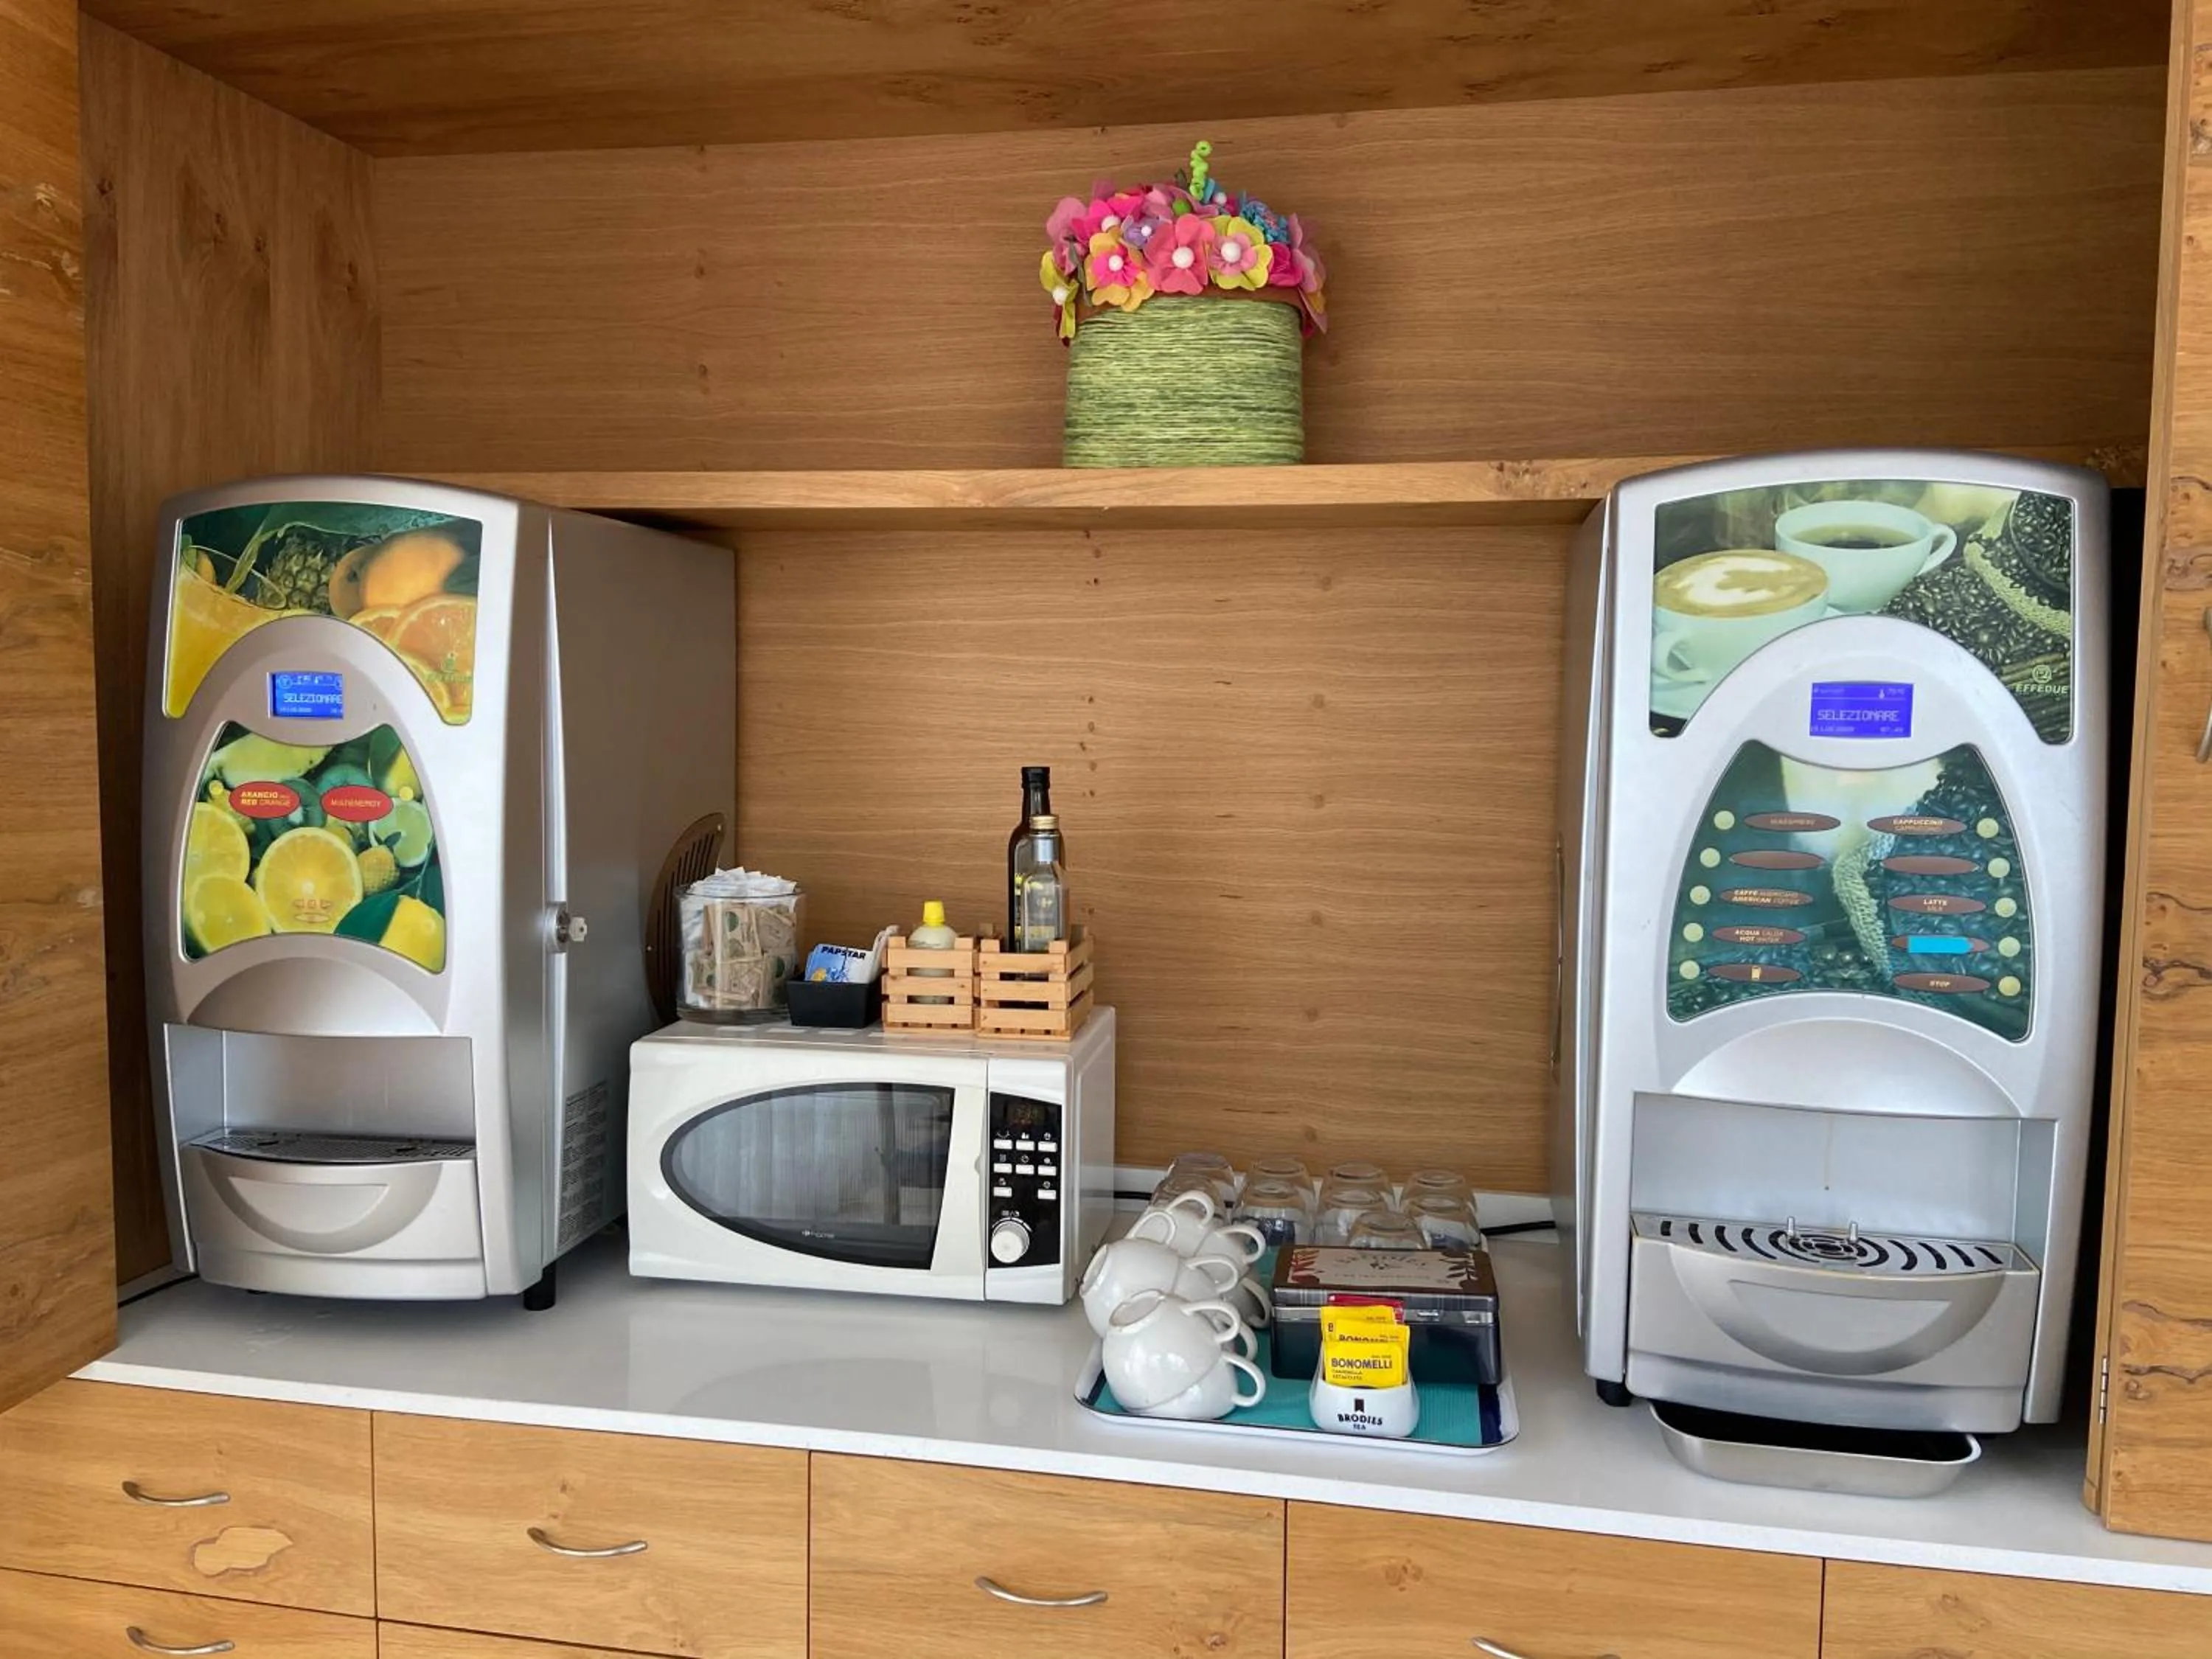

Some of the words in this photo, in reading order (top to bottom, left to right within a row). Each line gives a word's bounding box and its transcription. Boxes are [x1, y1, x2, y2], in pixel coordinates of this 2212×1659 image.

[2015, 684, 2069, 694] EFFEDUE
[1817, 709, 1899, 722] SELEZIONARE
[821, 946, 866, 960] PAPSTAR
[1331, 1357, 1393, 1369] BONOMELLI
[1338, 1413, 1383, 1425] BRODIES
